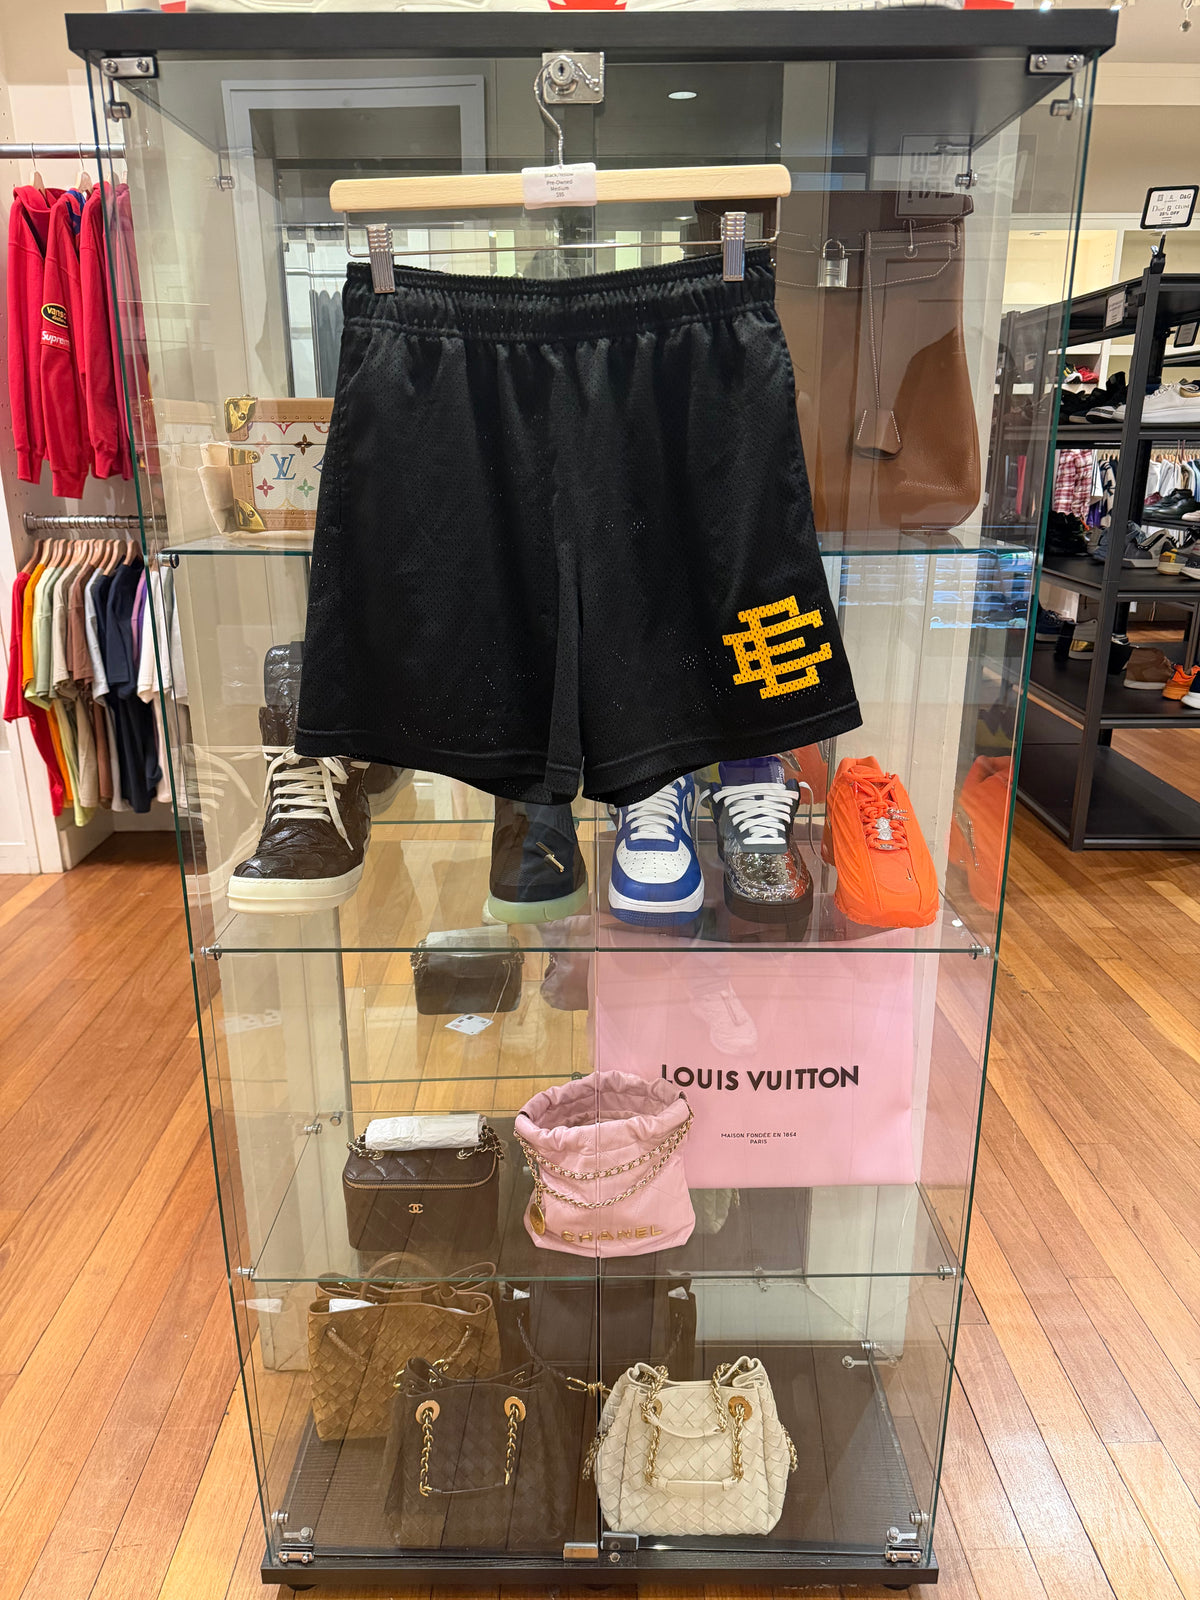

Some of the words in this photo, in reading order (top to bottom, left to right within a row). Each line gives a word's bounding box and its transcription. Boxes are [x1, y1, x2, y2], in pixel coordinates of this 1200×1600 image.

[662, 1064, 739, 1091] LOUIS
[747, 1065, 859, 1091] VUITTON
[561, 1224, 663, 1242] CHANEL
